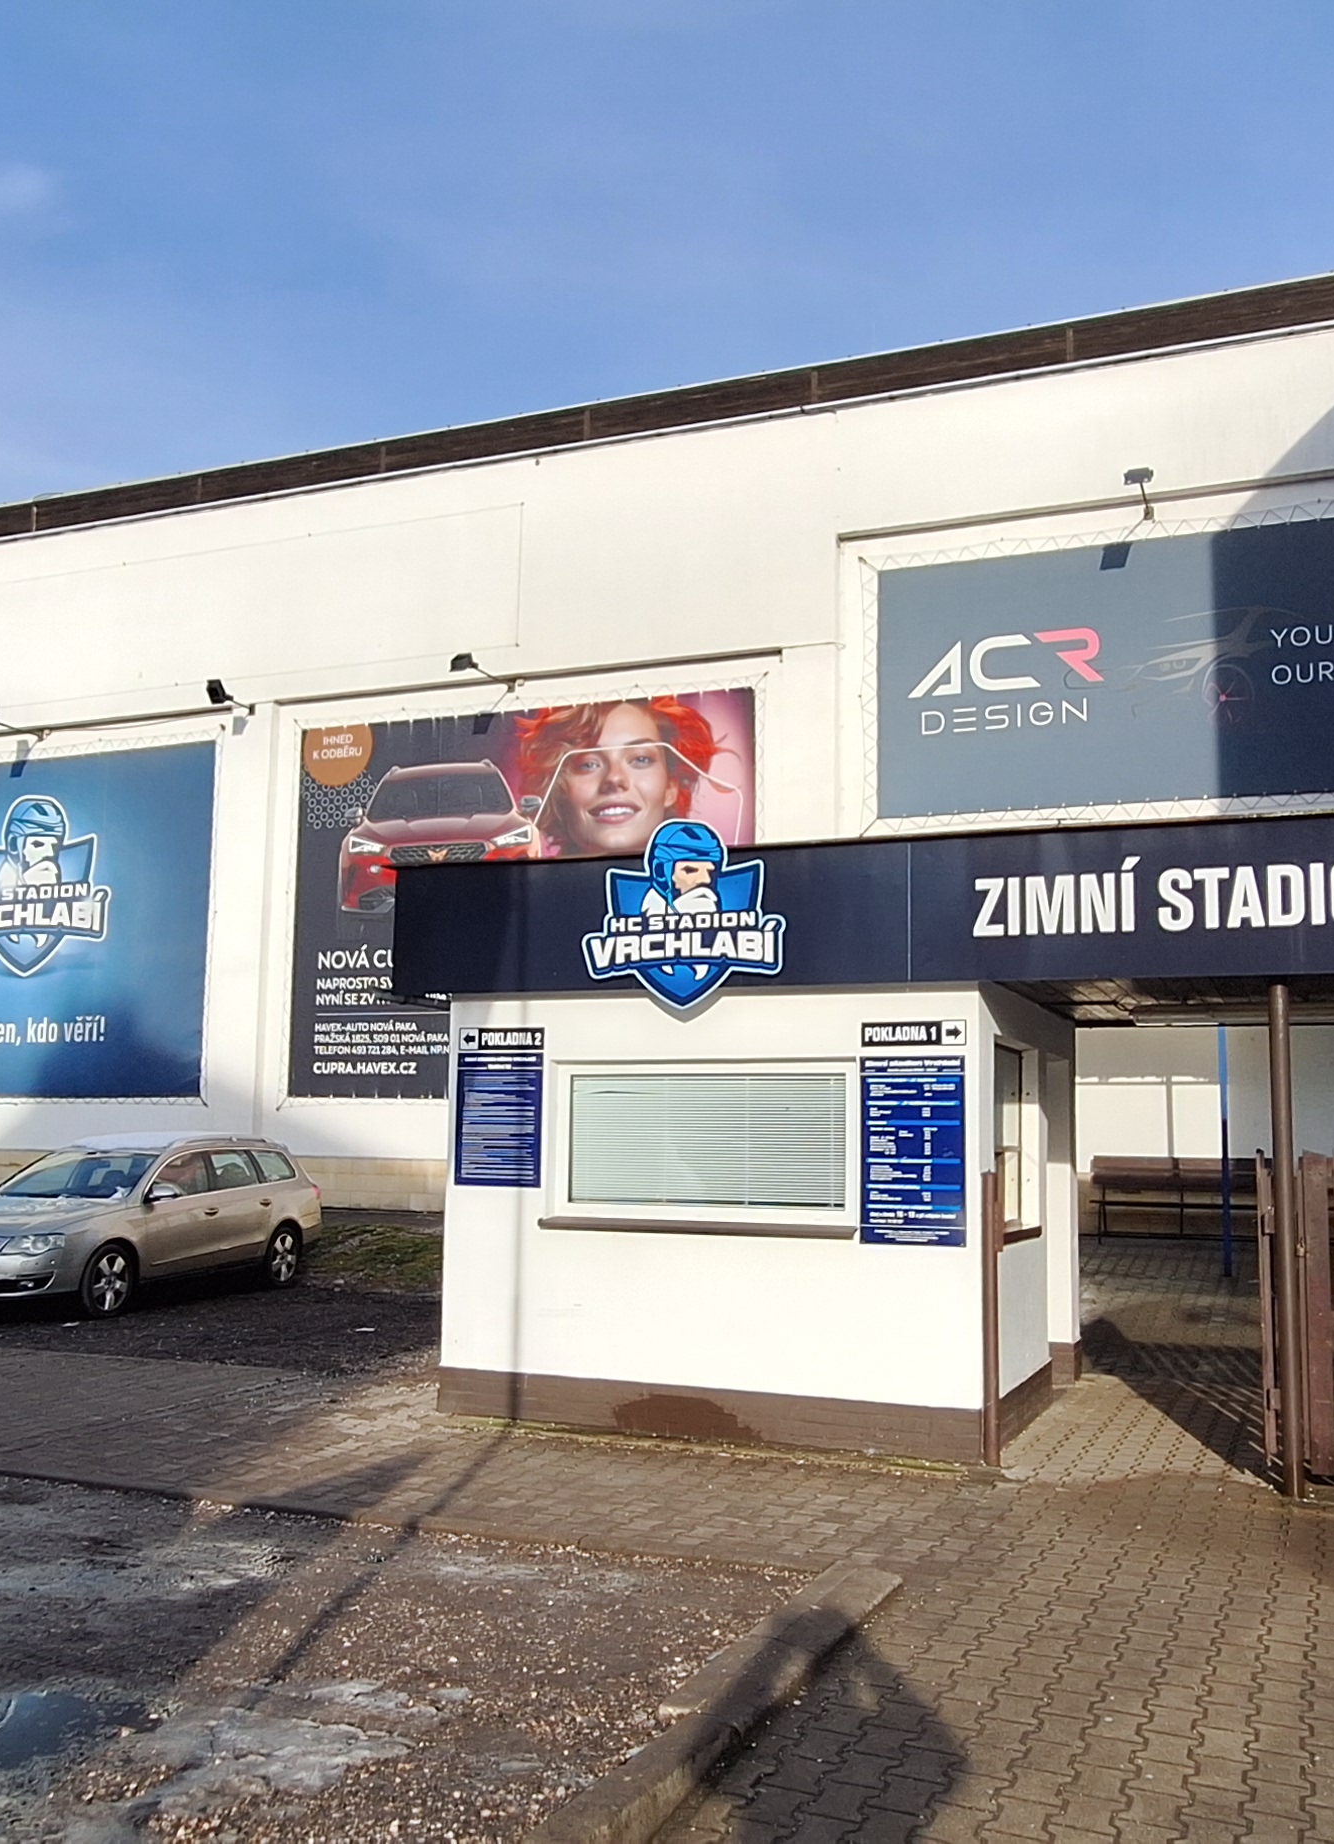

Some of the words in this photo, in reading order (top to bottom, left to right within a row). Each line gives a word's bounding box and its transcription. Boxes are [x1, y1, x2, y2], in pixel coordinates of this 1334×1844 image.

[908, 627, 1105, 699] ACR
[1271, 660, 1334, 685] OUR
[921, 697, 1089, 735] DESIGN
[322, 733, 354, 746] IHNED
[312, 749, 320, 760] K
[320, 745, 363, 759] ODBĚRU
[1, 883, 89, 901] STADION
[972, 855, 1142, 938] ZIMNÍ
[610, 916, 643, 932] HC
[648, 911, 756, 931] STADION
[590, 920, 778, 969] VRCHLABÍ
[317, 944, 370, 970] NOVÁ
[316, 976, 378, 990] NAPROSTO
[316, 990, 345, 1006] NYNÍ
[344, 993, 358, 1006] SE
[26, 1016, 58, 1043] kdo
[63, 1015, 106, 1043] věří!
[370, 1019, 394, 1032] NOVÁ
[395, 1021, 418, 1032] PAKA
[864, 1025, 928, 1042] POKLADNA
[930, 1026, 937, 1041] 1
[314, 1032, 351, 1044] PRAŽSKÁ
[401, 1031, 426, 1043] NOVÁ
[427, 1033, 449, 1043] PAKA
[481, 1031, 533, 1046] POKLADNA
[534, 1032, 542, 1046] 2
[314, 1045, 351, 1055] TELEFON
[313, 1061, 418, 1075] CUPRA.HAVEX.CZ
